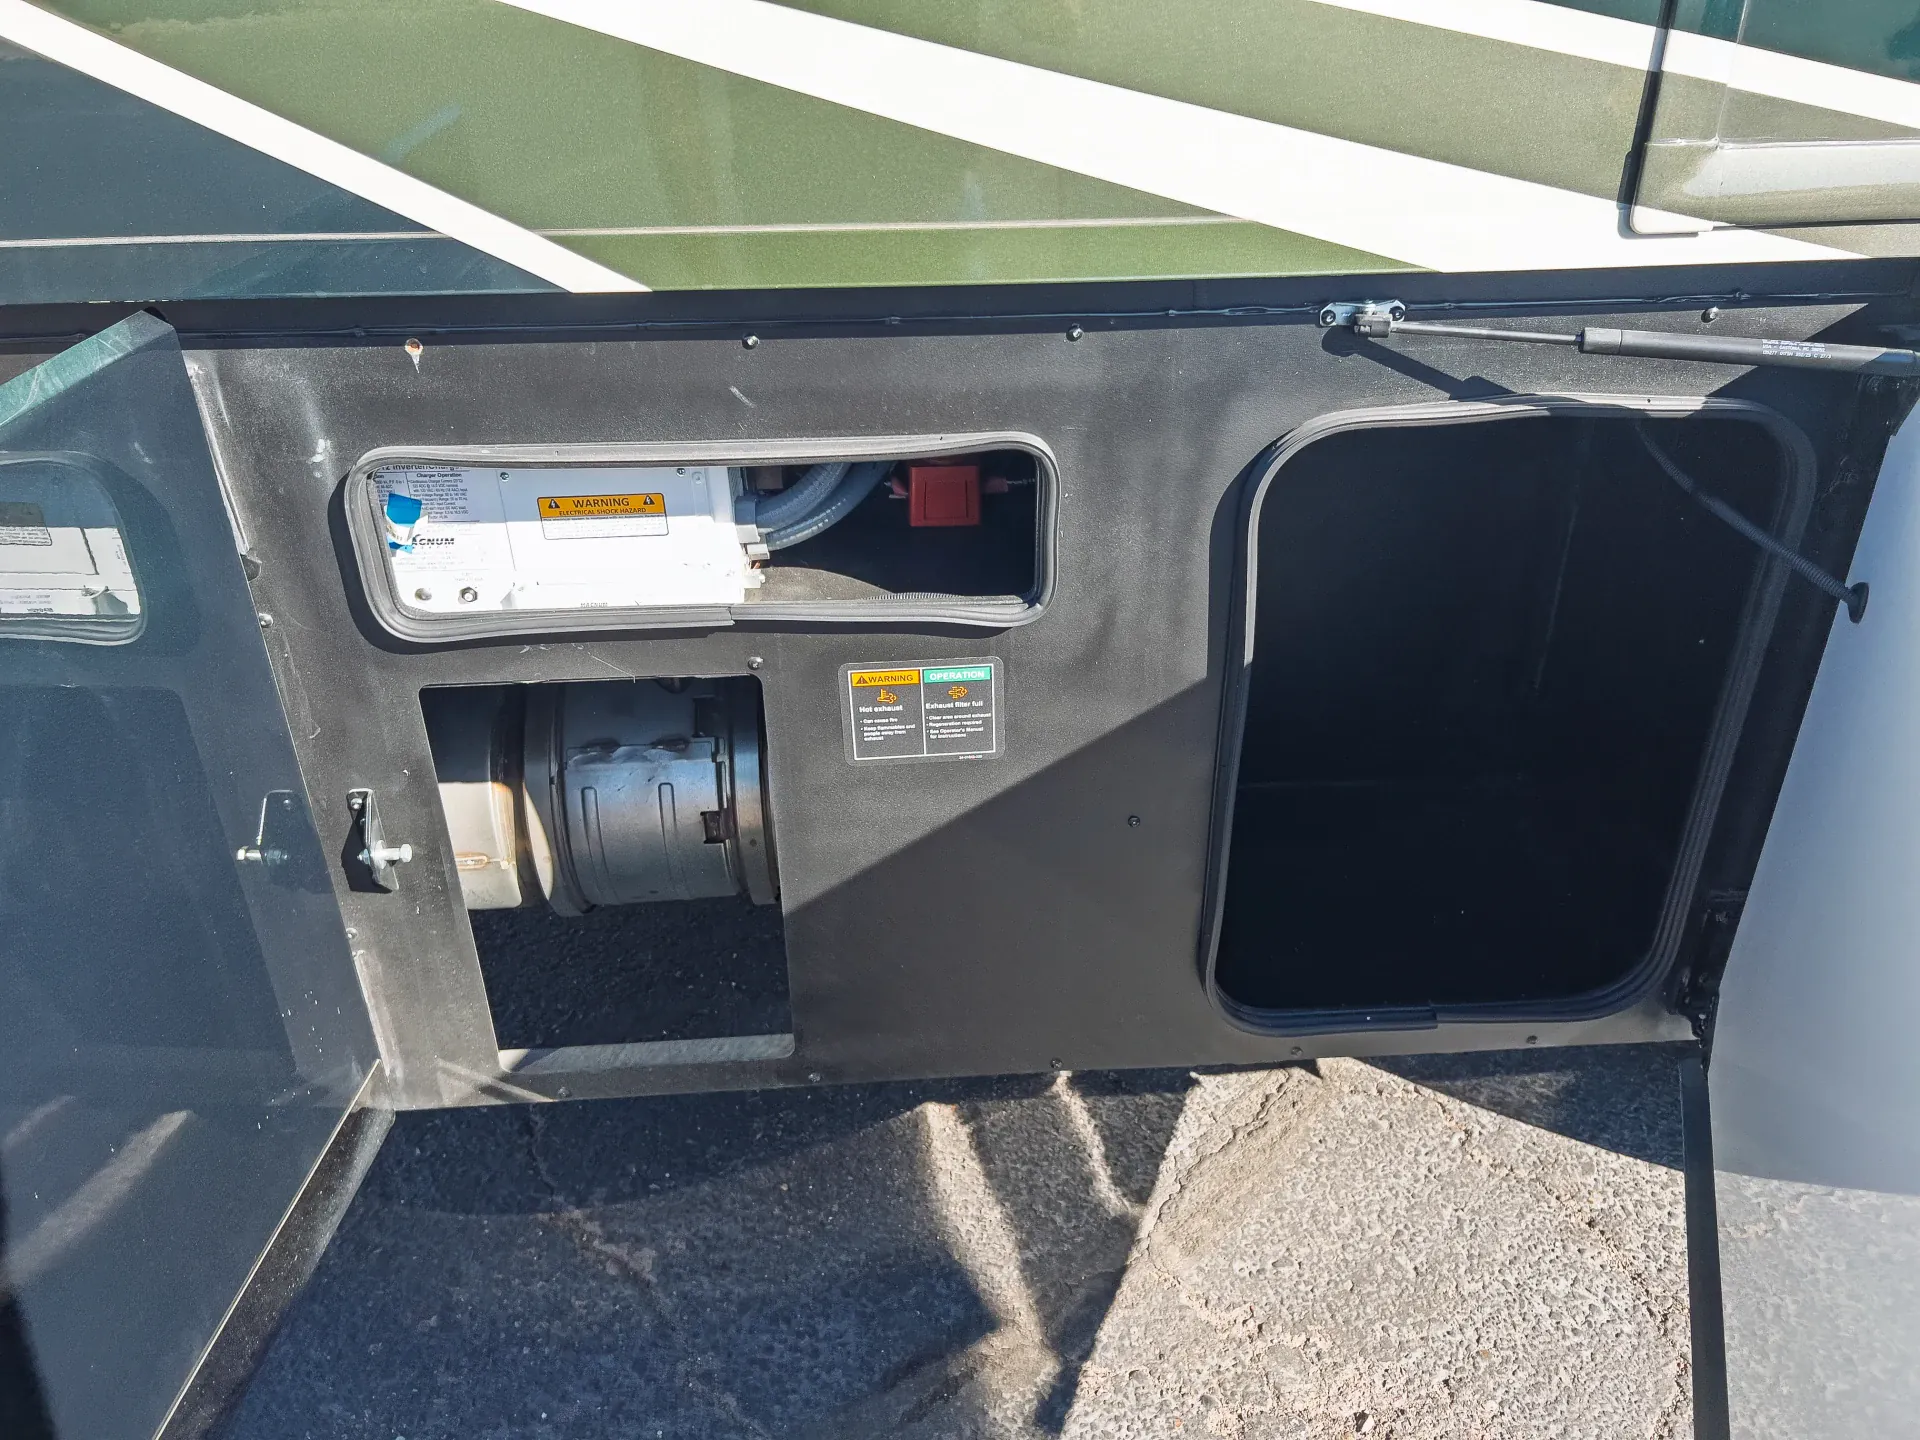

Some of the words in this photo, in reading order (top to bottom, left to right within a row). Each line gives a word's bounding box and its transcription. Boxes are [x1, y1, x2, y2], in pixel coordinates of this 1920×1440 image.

[572, 497, 630, 508] WARNING
[868, 674, 914, 683] WARNING
[929, 671, 985, 681] OPERATION
[873, 704, 904, 712] exhaust
